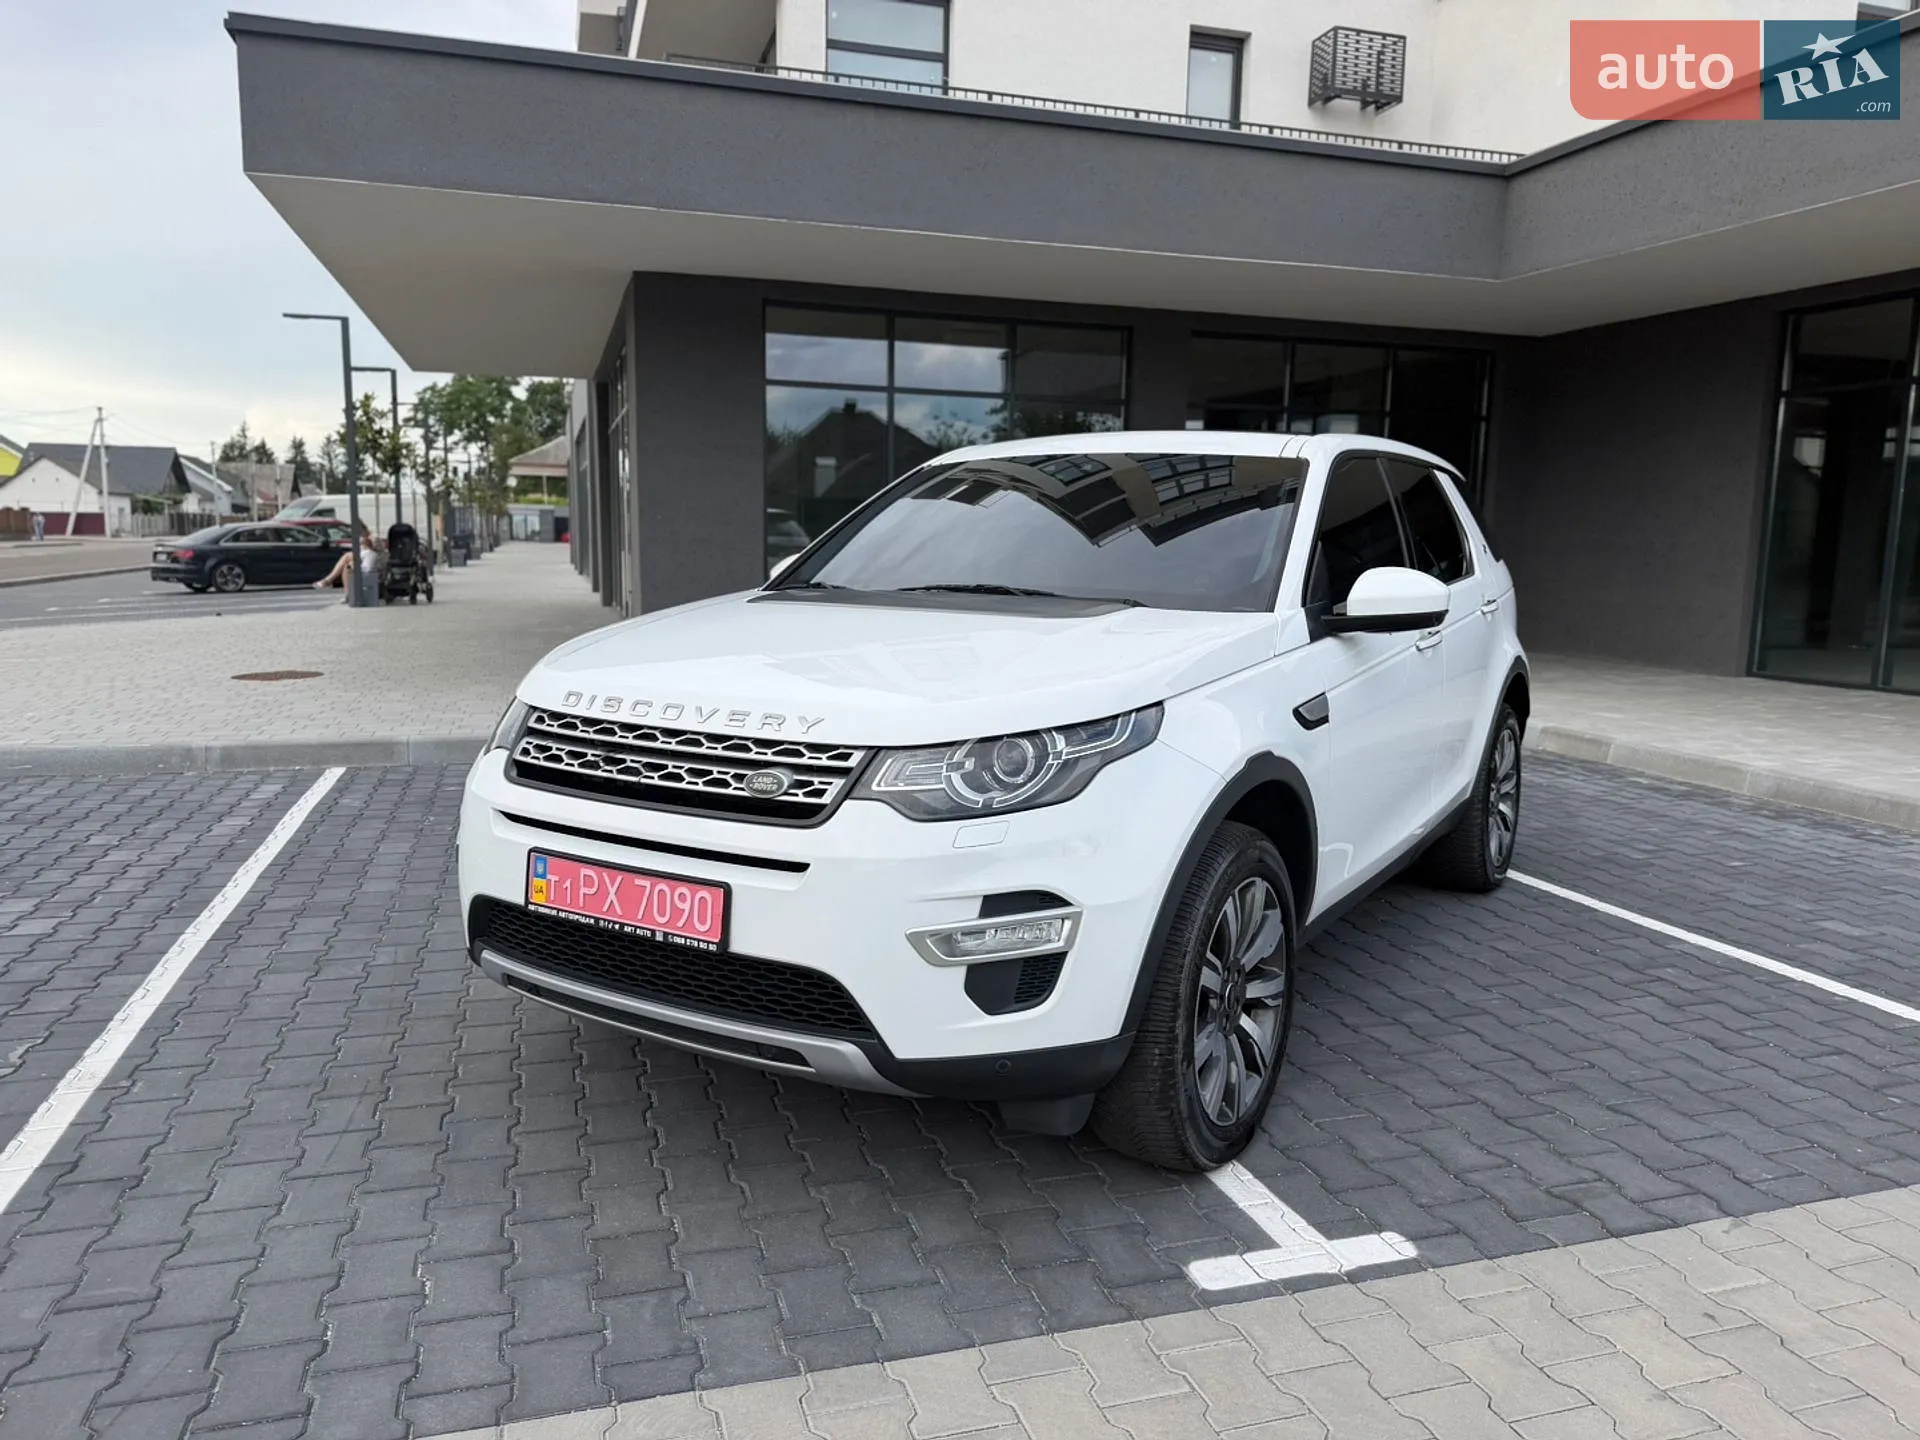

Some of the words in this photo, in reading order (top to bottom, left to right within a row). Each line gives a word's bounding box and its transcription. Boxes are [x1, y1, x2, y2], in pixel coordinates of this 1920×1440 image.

[561, 689, 825, 734] DISCOVERY
[533, 884, 544, 895] UA
[634, 878, 712, 933] 7090
